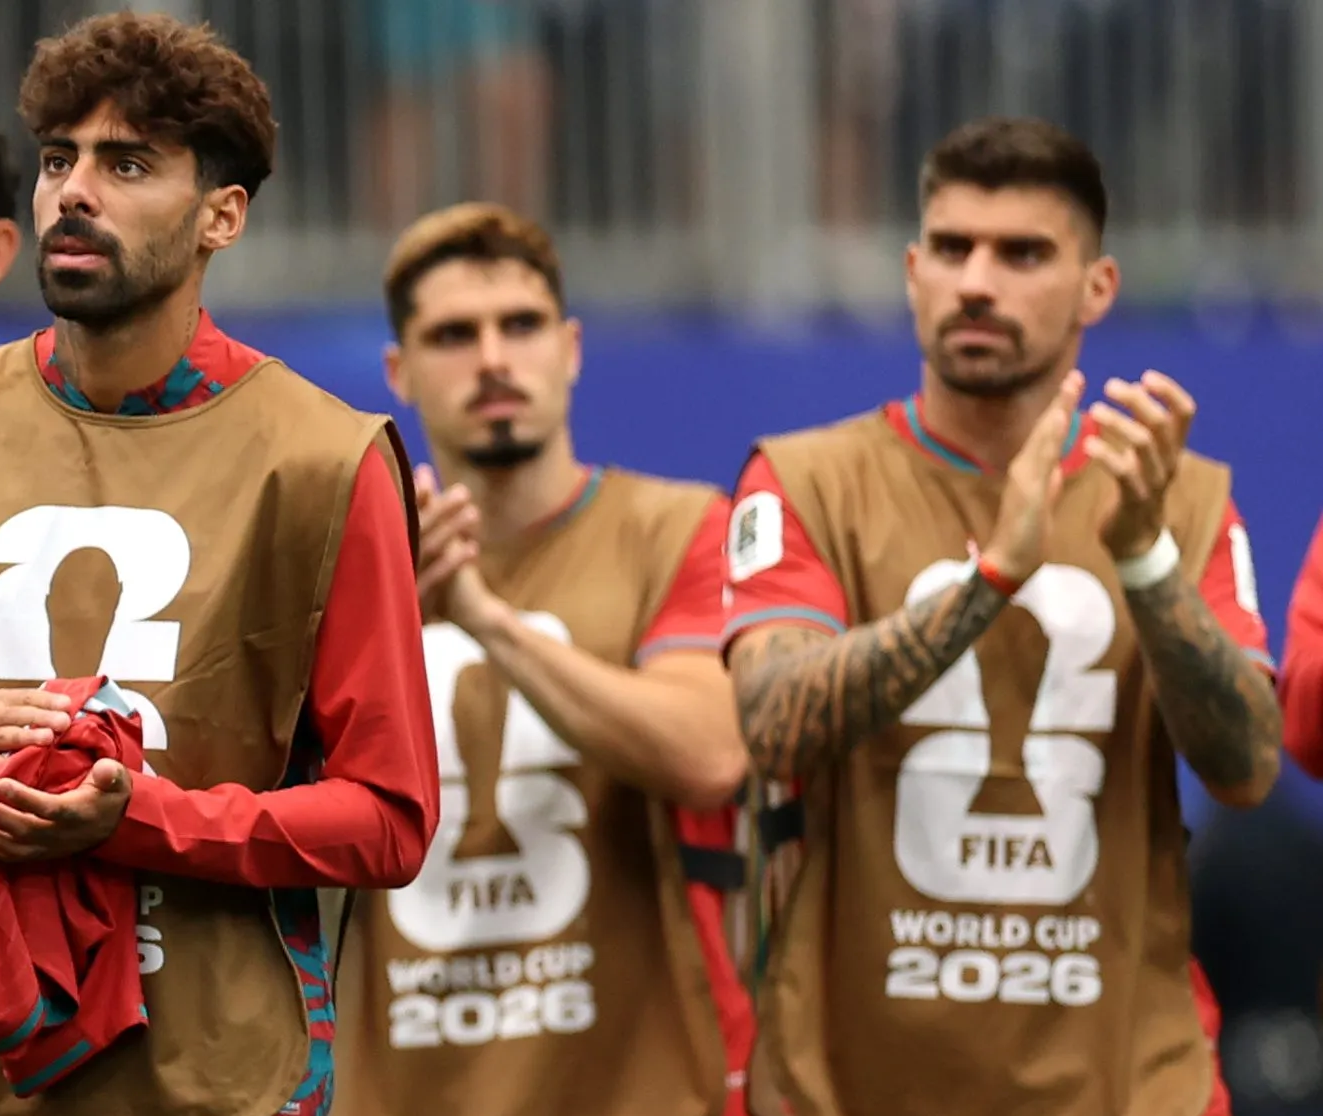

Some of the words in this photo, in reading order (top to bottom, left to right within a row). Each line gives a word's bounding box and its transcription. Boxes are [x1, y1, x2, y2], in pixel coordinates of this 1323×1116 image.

[960, 835, 1053, 869] FIFA
[449, 873, 537, 914] FIFA
[890, 910, 1031, 949] WORLD
[1035, 915, 1102, 951] CUP
[386, 952, 522, 995] WORLD
[524, 942, 595, 983] CUP
[885, 945, 1103, 1007] 2026
[388, 978, 597, 1049] 2026
